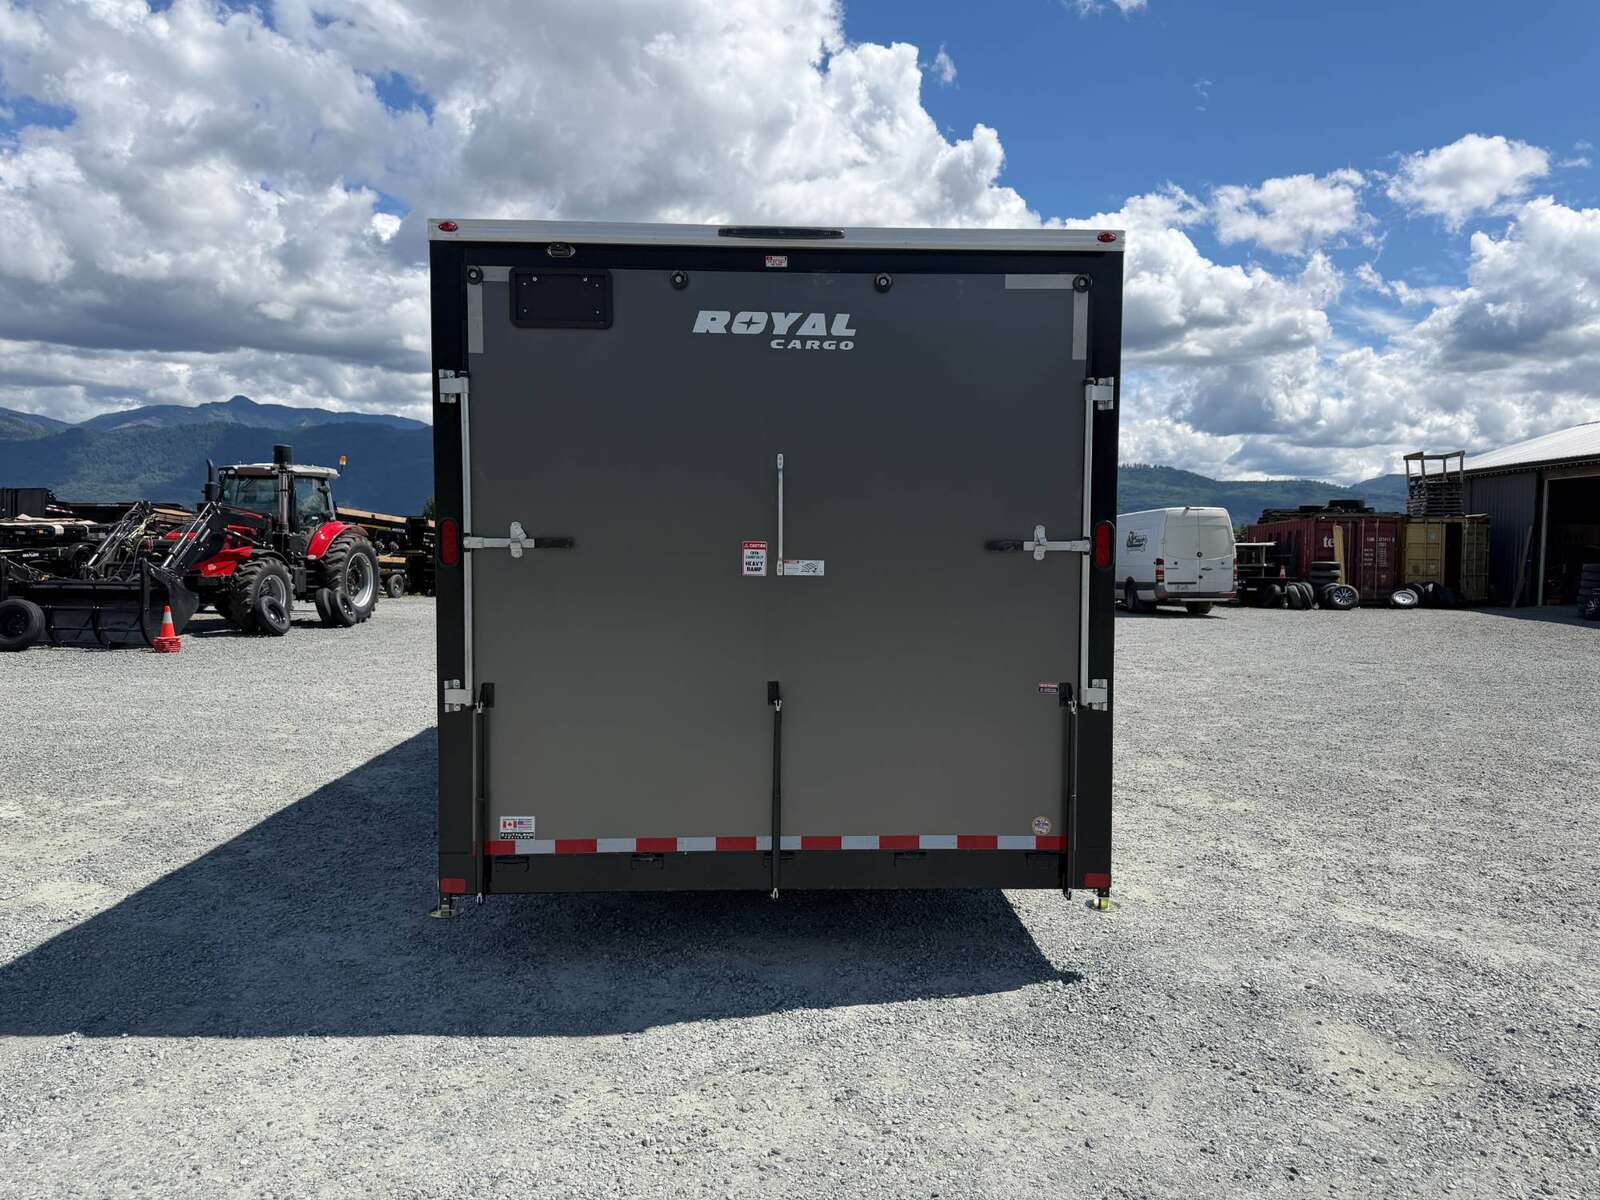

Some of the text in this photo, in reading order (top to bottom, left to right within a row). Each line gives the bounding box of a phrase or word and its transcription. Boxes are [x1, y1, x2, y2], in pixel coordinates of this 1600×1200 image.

[692, 310, 856, 336] ROYAL
[770, 339, 854, 350] CARGO
[1323, 535, 1334, 548] te
